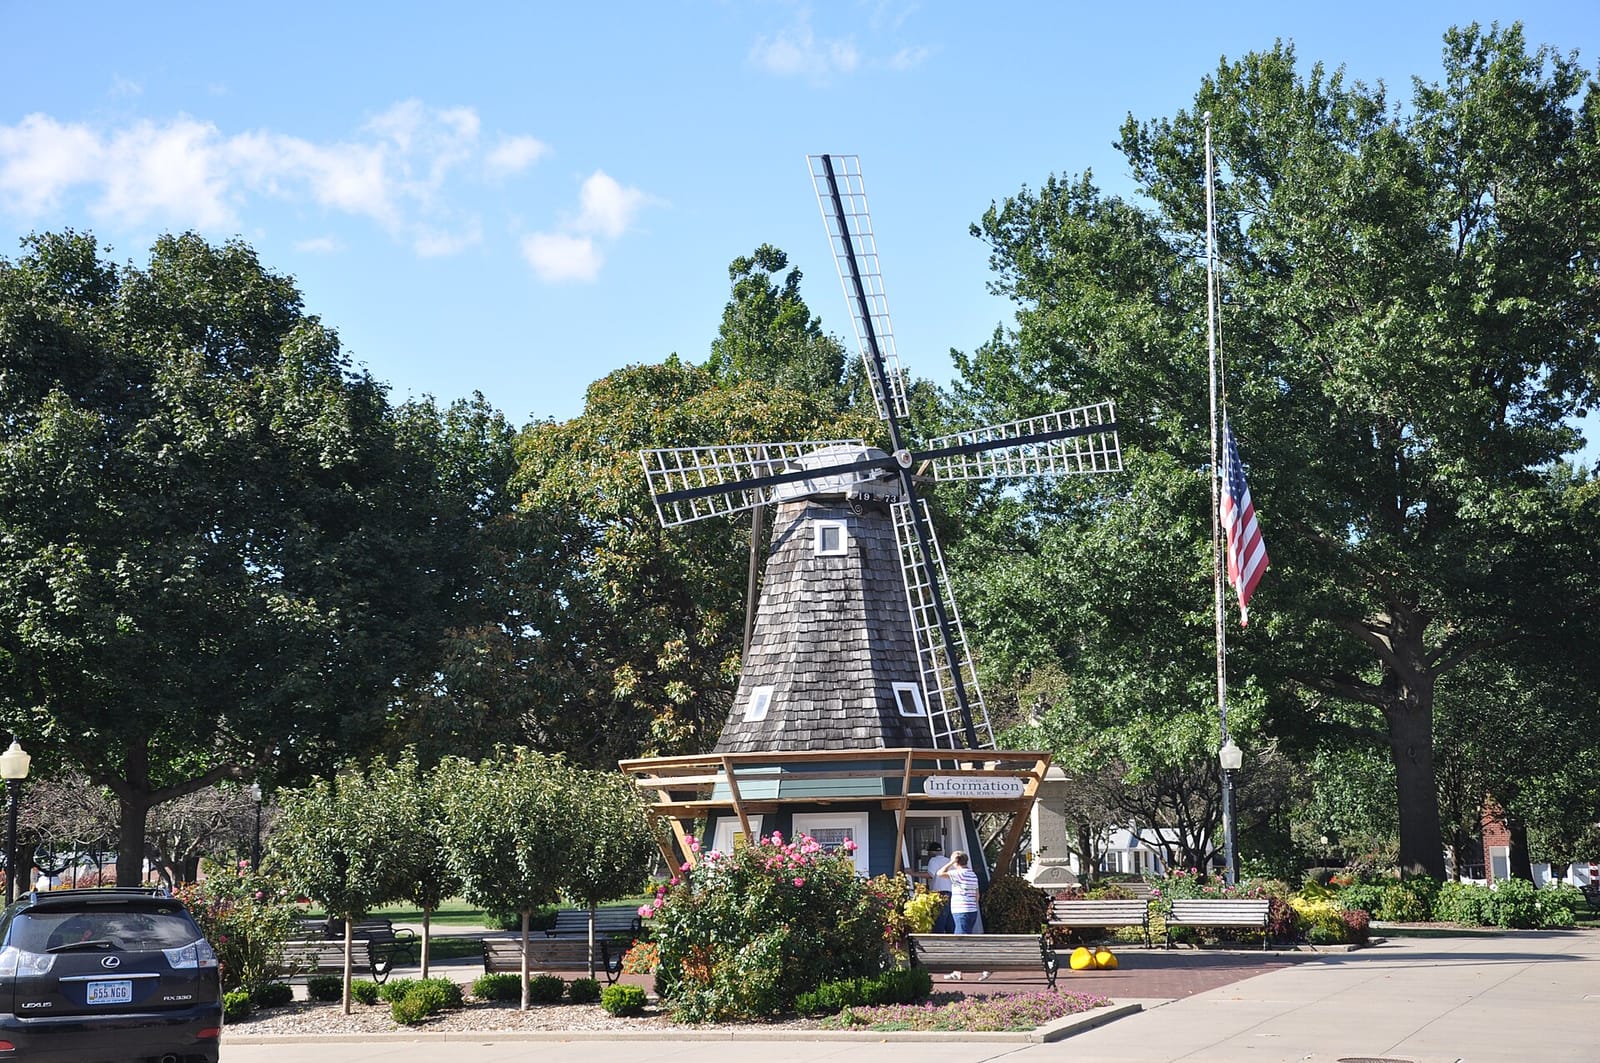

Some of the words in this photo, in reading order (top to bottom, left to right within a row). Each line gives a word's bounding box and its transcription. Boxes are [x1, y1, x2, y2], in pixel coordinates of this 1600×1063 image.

[859, 492, 870, 501] 19
[885, 494, 897, 503] 73
[930, 779, 1019, 791] Information
[93, 988, 109, 999] 655
[21, 1001, 53, 1009] LEXUS
